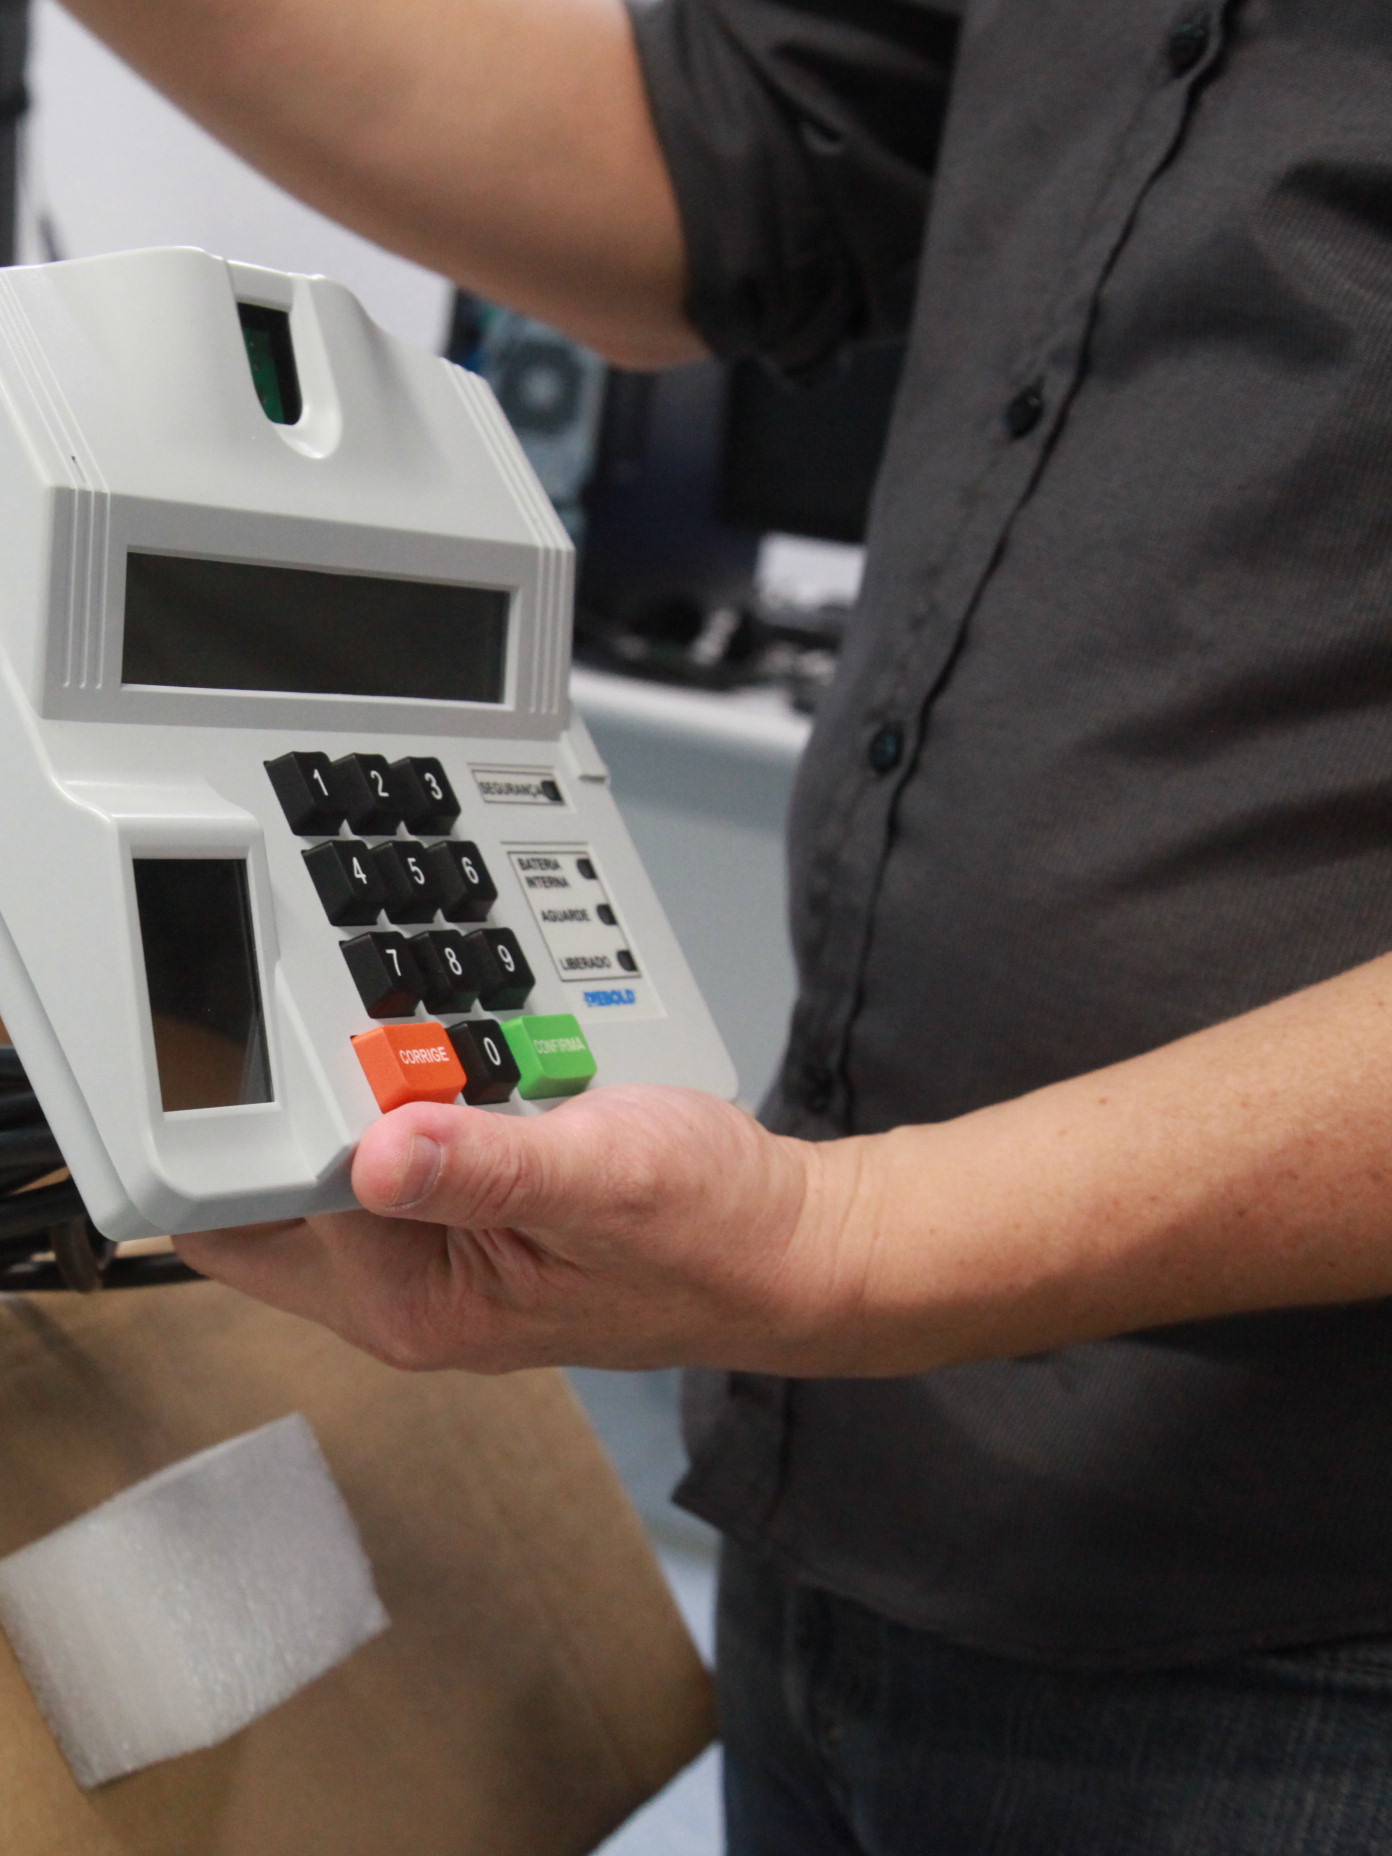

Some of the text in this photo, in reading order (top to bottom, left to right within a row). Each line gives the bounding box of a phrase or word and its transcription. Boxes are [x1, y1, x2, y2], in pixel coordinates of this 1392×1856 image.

[313, 768, 443, 800] 1 2 3
[352, 856, 479, 885] 4 5 6
[517, 858, 562, 870] BATERIA
[525, 876, 570, 888] INTERNA
[541, 909, 590, 922] AGUARDE
[385, 944, 515, 976] 7 8 9
[559, 956, 612, 971] LIBERADO
[483, 1037, 501, 1066] 0
[533, 1037, 586, 1054] CONFIRMA
[399, 1047, 450, 1065] CORRIGE
